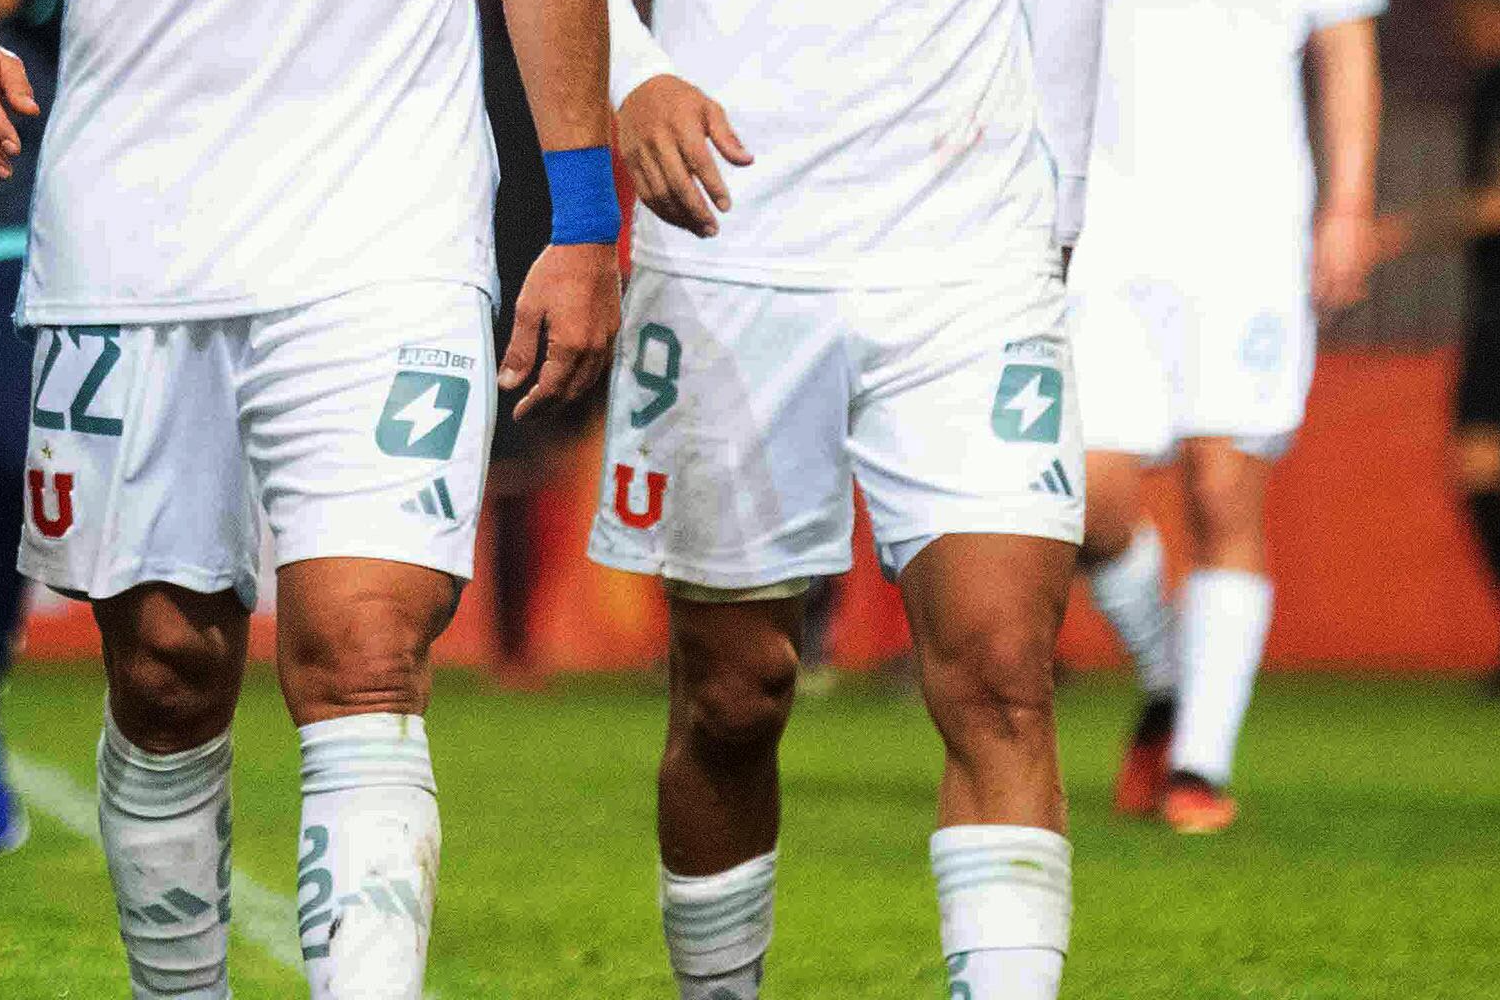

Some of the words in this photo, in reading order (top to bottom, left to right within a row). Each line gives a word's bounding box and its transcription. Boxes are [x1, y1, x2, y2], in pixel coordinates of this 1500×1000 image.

[32, 324, 124, 437] 22
[631, 321, 682, 429] 9
[28, 468, 75, 539] U
[613, 463, 668, 530] U
